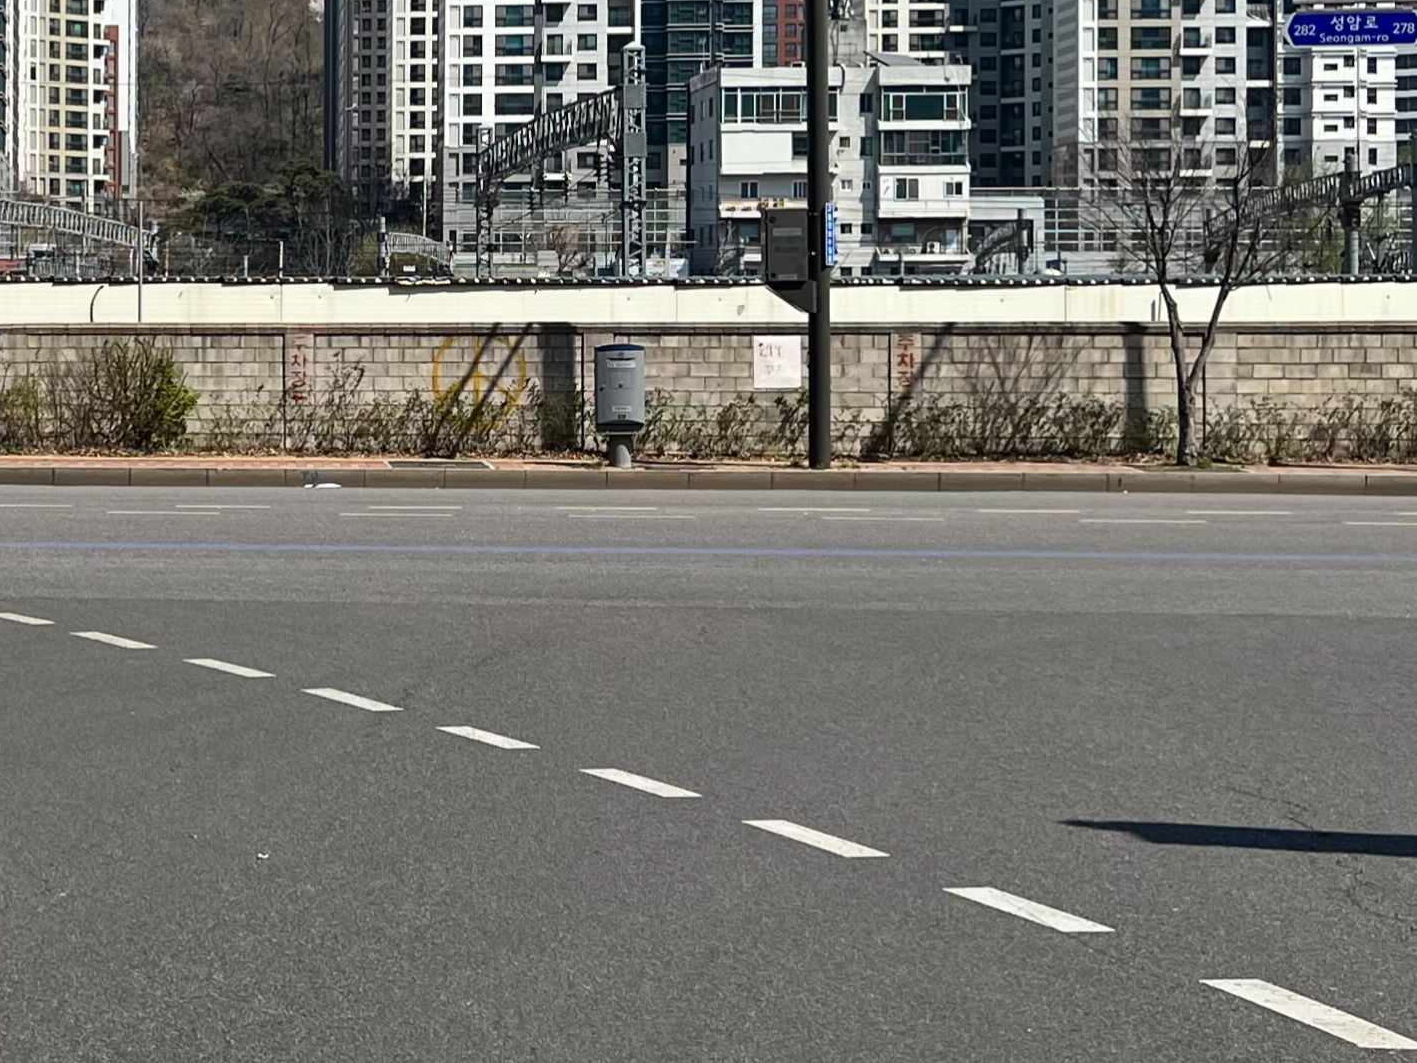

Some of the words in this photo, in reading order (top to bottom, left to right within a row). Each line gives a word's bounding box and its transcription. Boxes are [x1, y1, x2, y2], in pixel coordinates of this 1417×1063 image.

[1330, 15, 1379, 32] 성암로
[1393, 22, 1415, 35] 278
[1293, 24, 1316, 37] 282
[1319, 33, 1389, 44] Seongam-ro
[897, 334, 915, 387] 주차장
